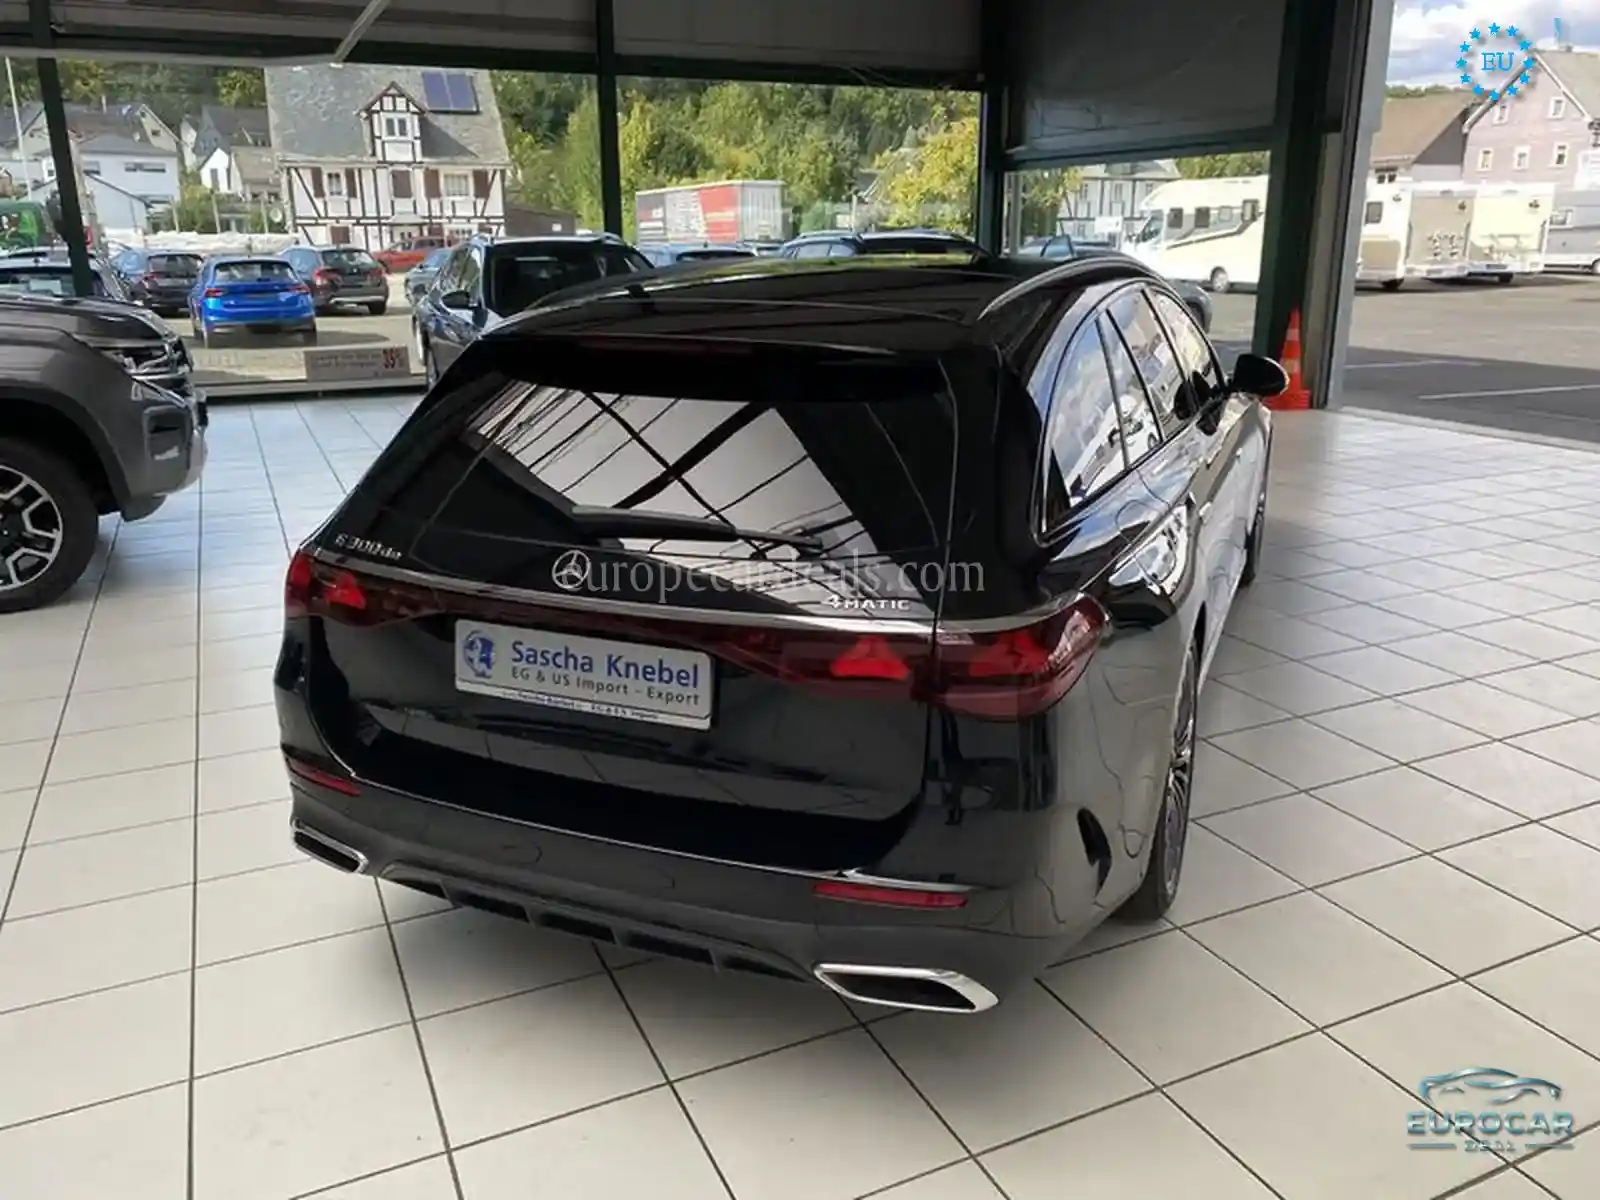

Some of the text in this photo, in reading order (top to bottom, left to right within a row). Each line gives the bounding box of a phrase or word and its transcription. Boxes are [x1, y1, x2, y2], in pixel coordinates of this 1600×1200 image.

[826, 594, 910, 610] 4MATIC
[511, 640, 699, 689] Sascha Knebel
[511, 665, 530, 681] EG
[535, 669, 546, 684] &
[552, 673, 571, 687] US
[576, 676, 629, 696] Import
[646, 686, 699, 706] Export
